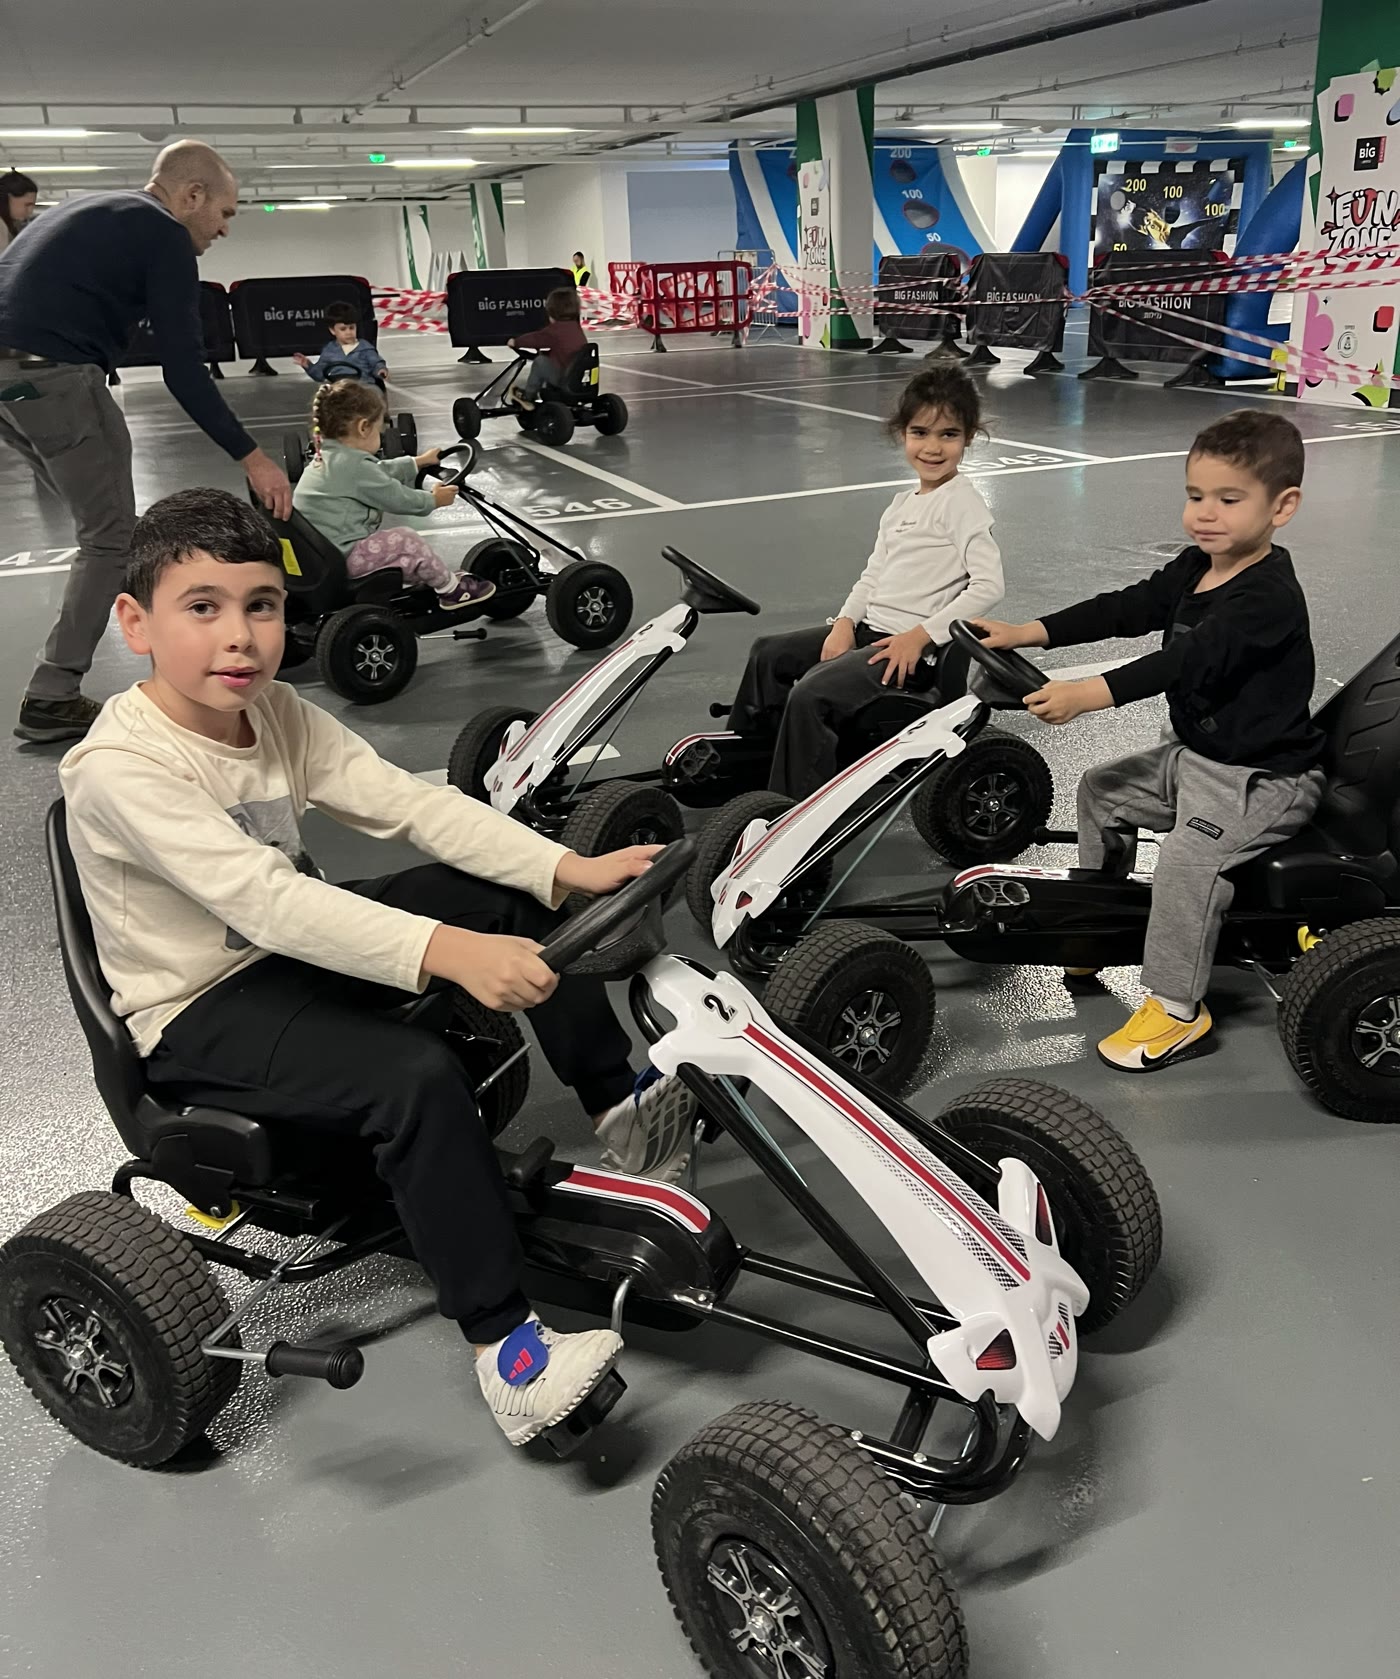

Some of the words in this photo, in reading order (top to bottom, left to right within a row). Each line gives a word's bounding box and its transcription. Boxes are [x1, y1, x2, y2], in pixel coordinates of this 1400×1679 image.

[890, 147, 912, 159] 200
[1125, 179, 1147, 192] 200
[902, 189, 923, 199] 100
[1163, 186, 1183, 198] 100
[1205, 204, 1225, 216] 100
[926, 233, 941, 242] 50
[907, 290, 939, 300] FASHION
[1002, 292, 1041, 302] FASHION
[287, 309, 324, 320] FASHI
[522, 498, 632, 517] 546
[0, 546, 81, 567] 47
[704, 994, 736, 1022] 2
